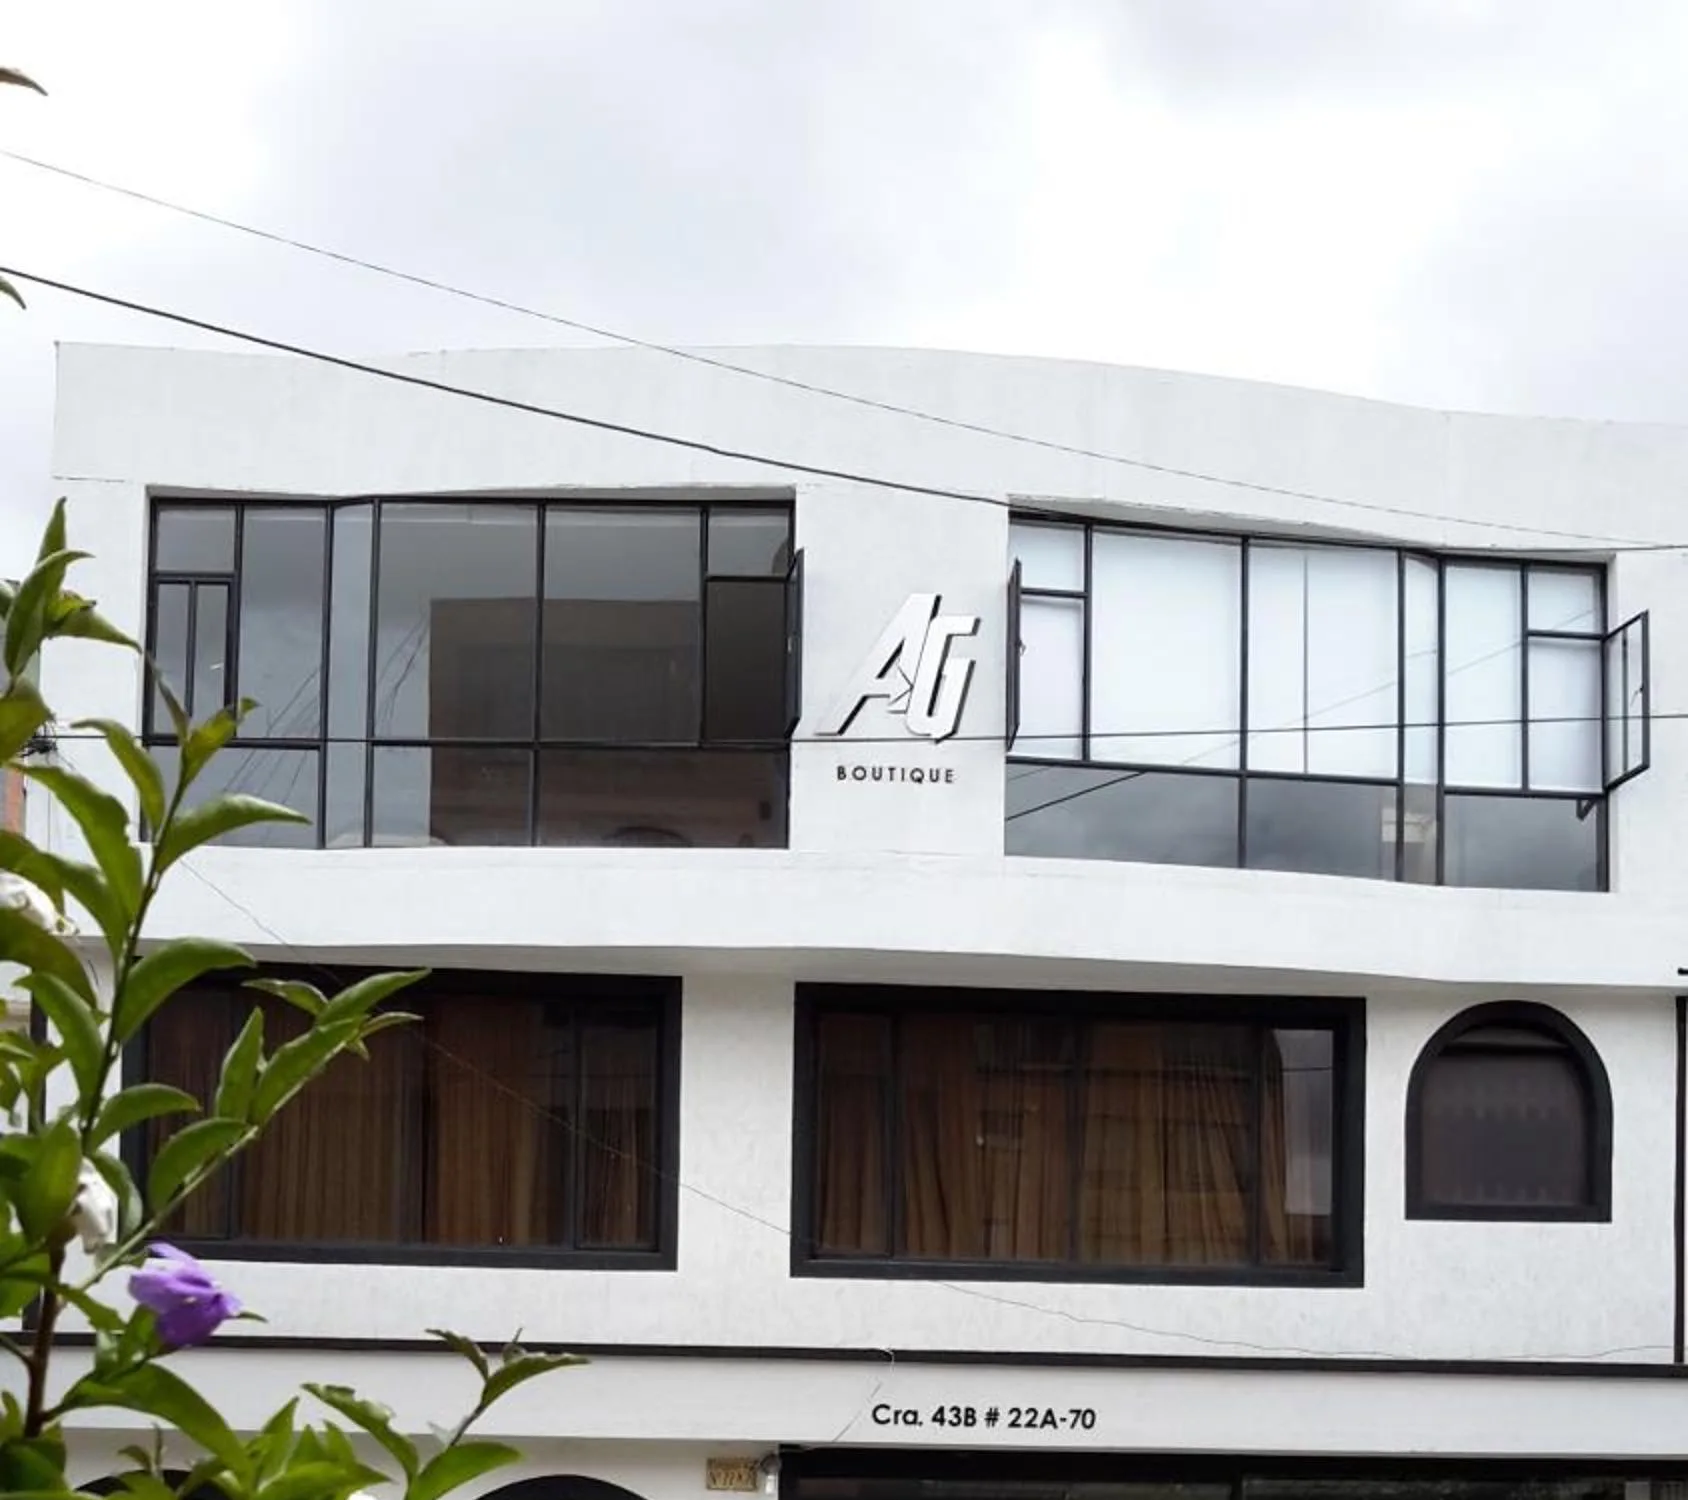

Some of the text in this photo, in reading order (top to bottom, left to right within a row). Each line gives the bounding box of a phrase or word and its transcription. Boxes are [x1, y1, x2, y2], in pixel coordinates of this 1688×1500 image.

[813, 592, 980, 744] AG
[836, 765, 954, 784] BOUTIQUE
[871, 1403, 1097, 1430] Cra. 43B # 22A-70
